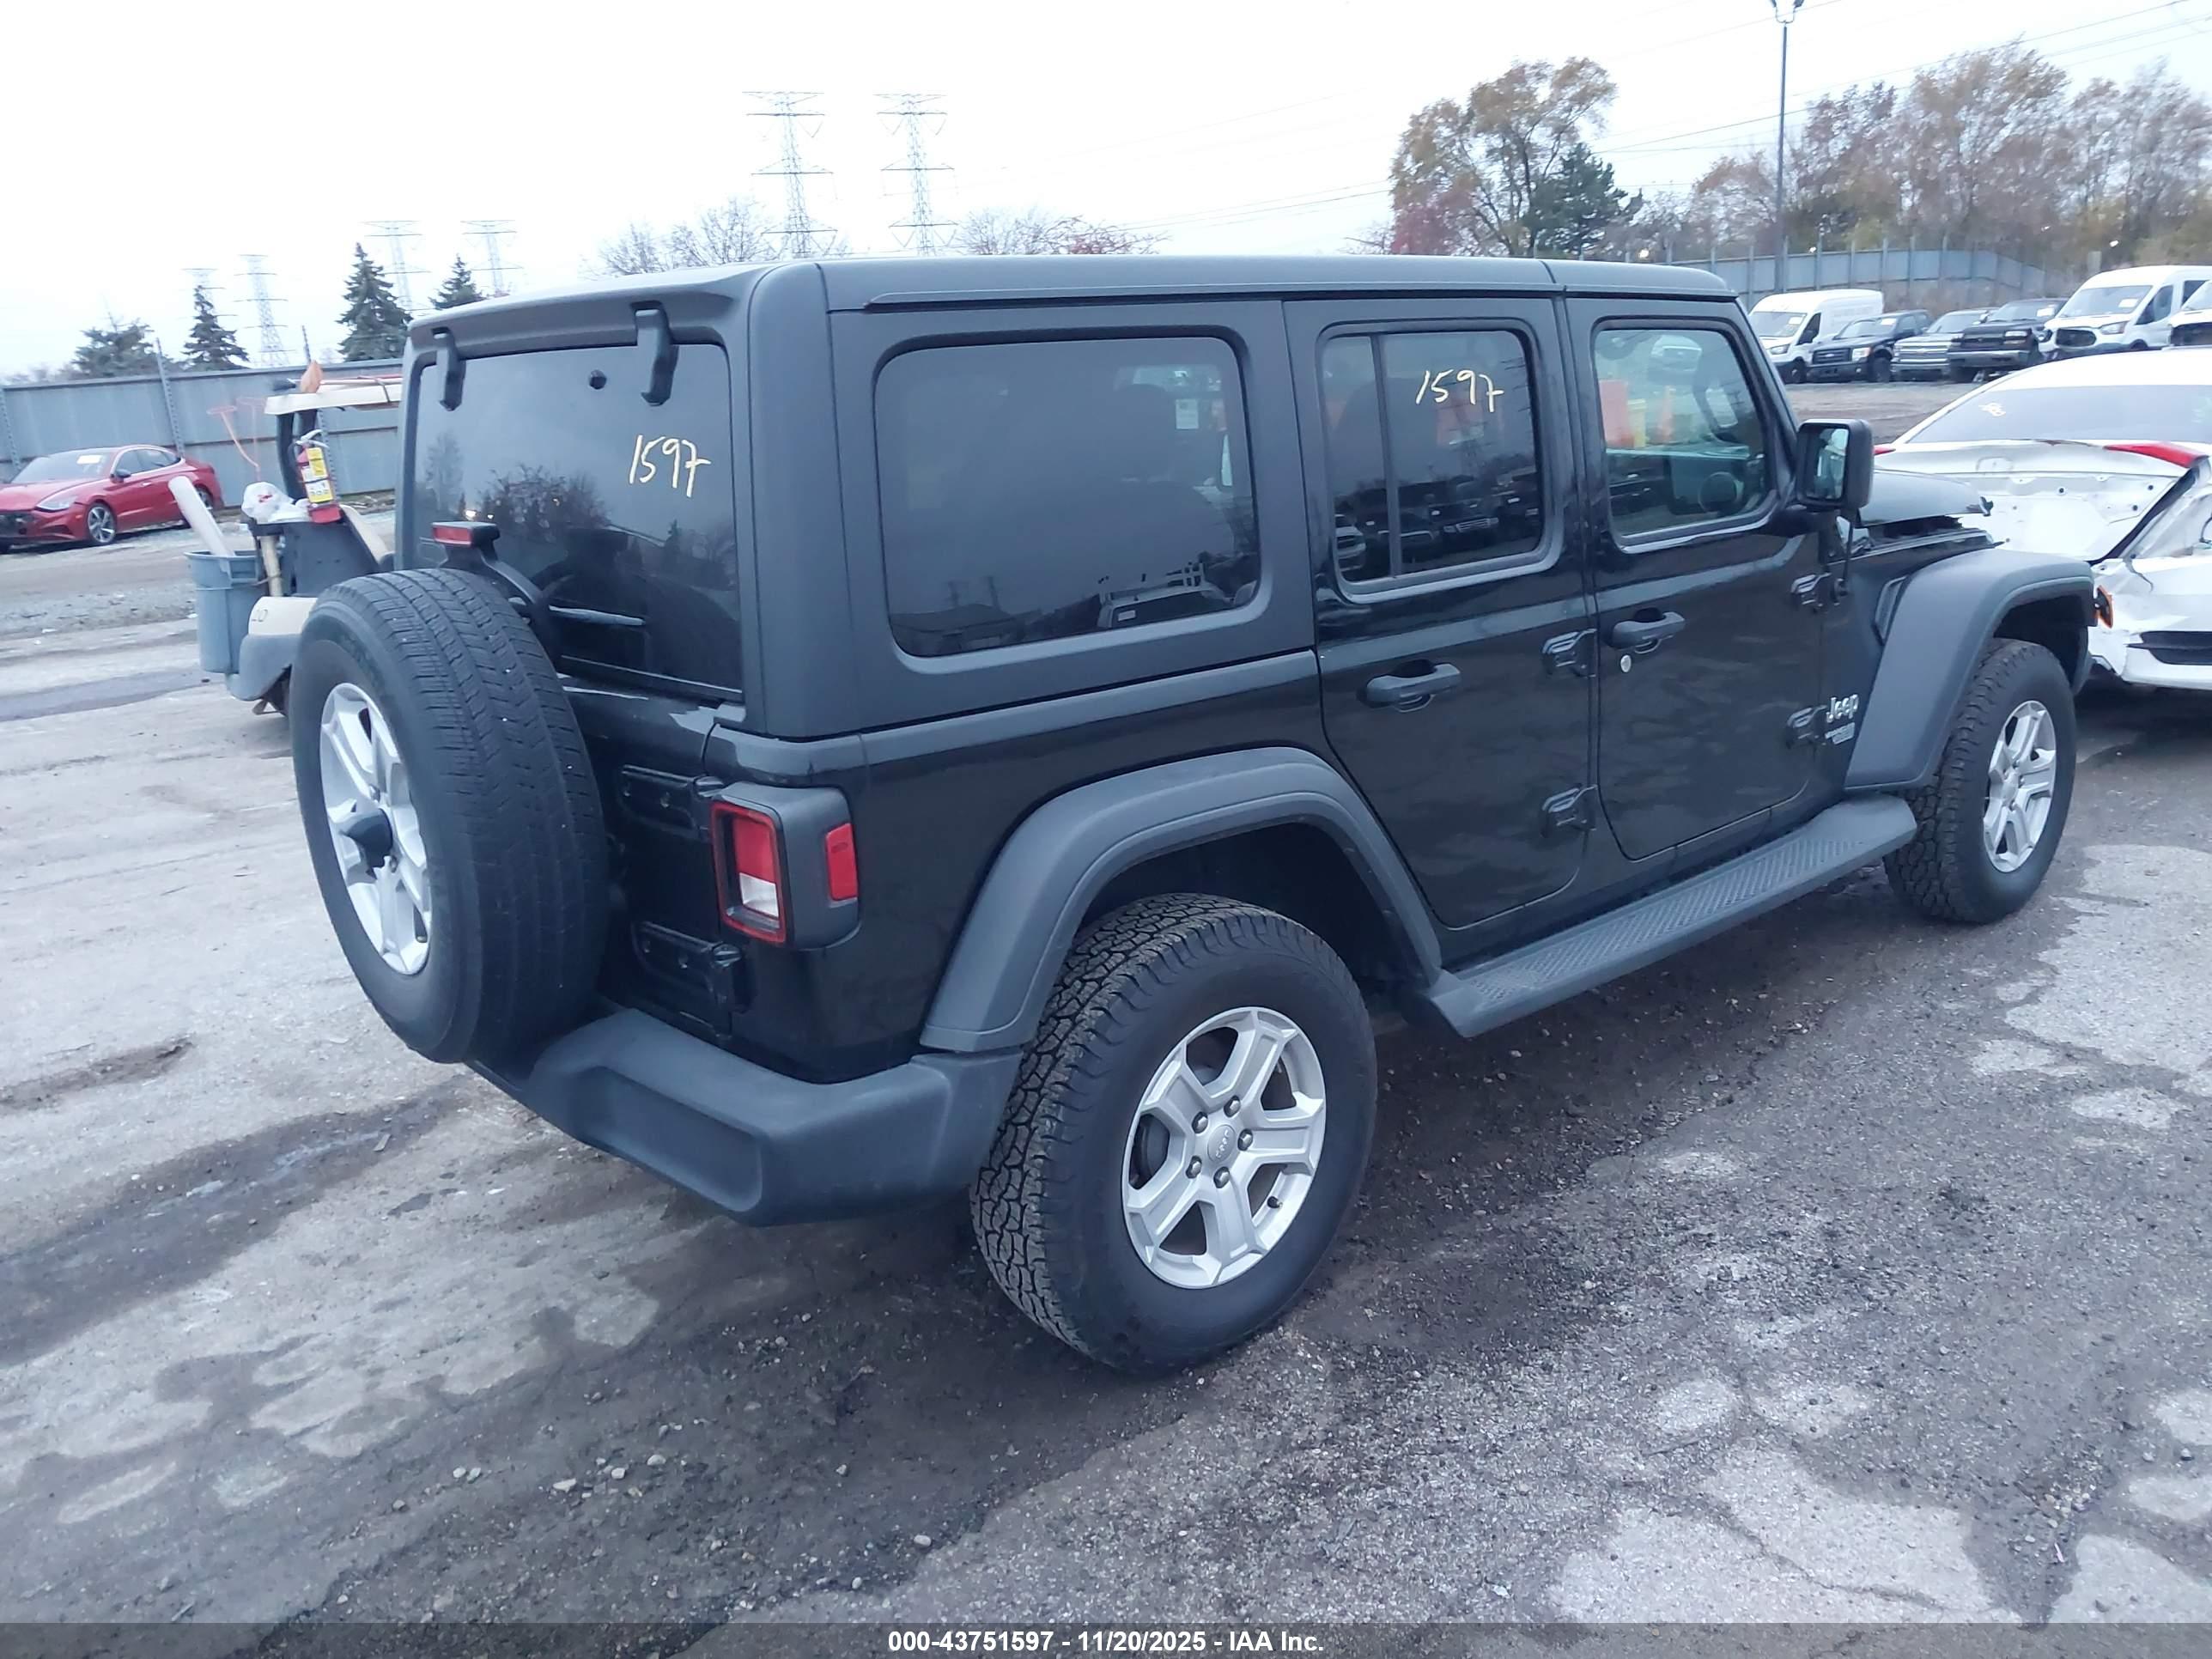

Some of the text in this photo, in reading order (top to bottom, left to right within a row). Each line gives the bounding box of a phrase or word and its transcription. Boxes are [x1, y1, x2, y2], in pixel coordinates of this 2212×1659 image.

[1415, 369, 1505, 413] 1597
[629, 434, 712, 498] 1597
[1826, 694, 1859, 723] Jeep
